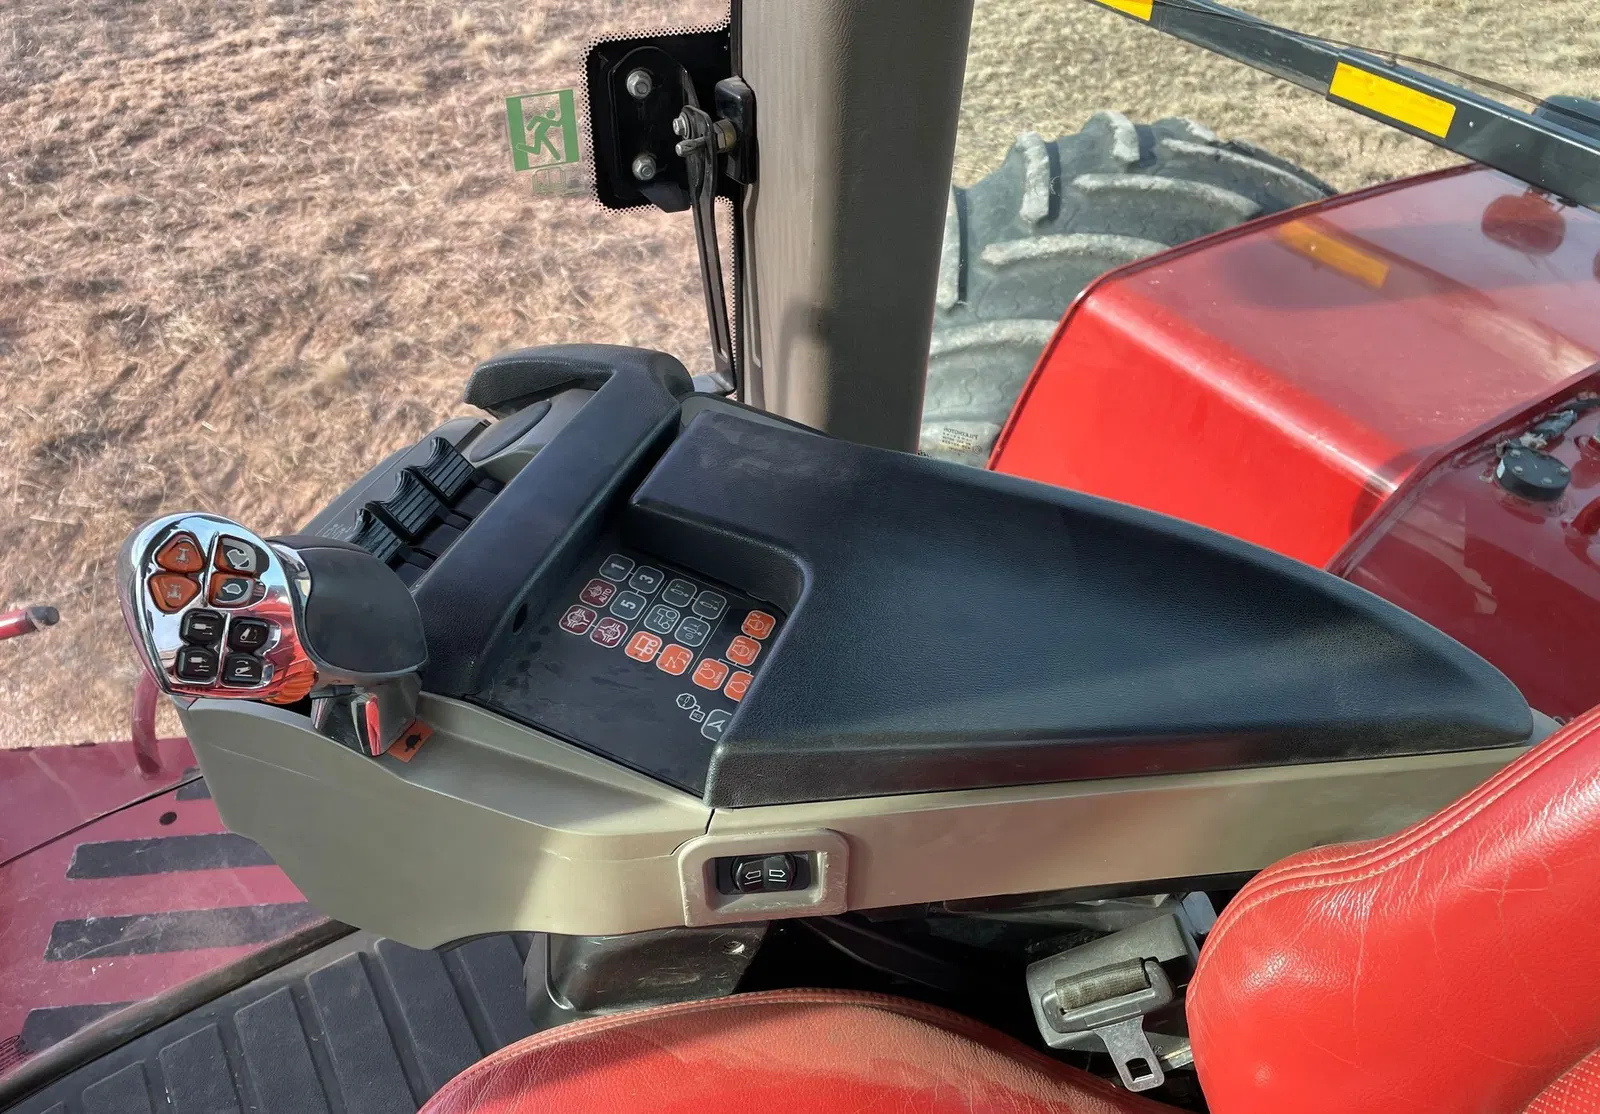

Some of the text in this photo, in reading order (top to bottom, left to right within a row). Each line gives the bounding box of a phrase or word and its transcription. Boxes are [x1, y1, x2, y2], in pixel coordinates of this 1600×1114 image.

[639, 574, 654, 584] 3
[599, 588, 612, 603] AUTO
[620, 600, 636, 610] 5
